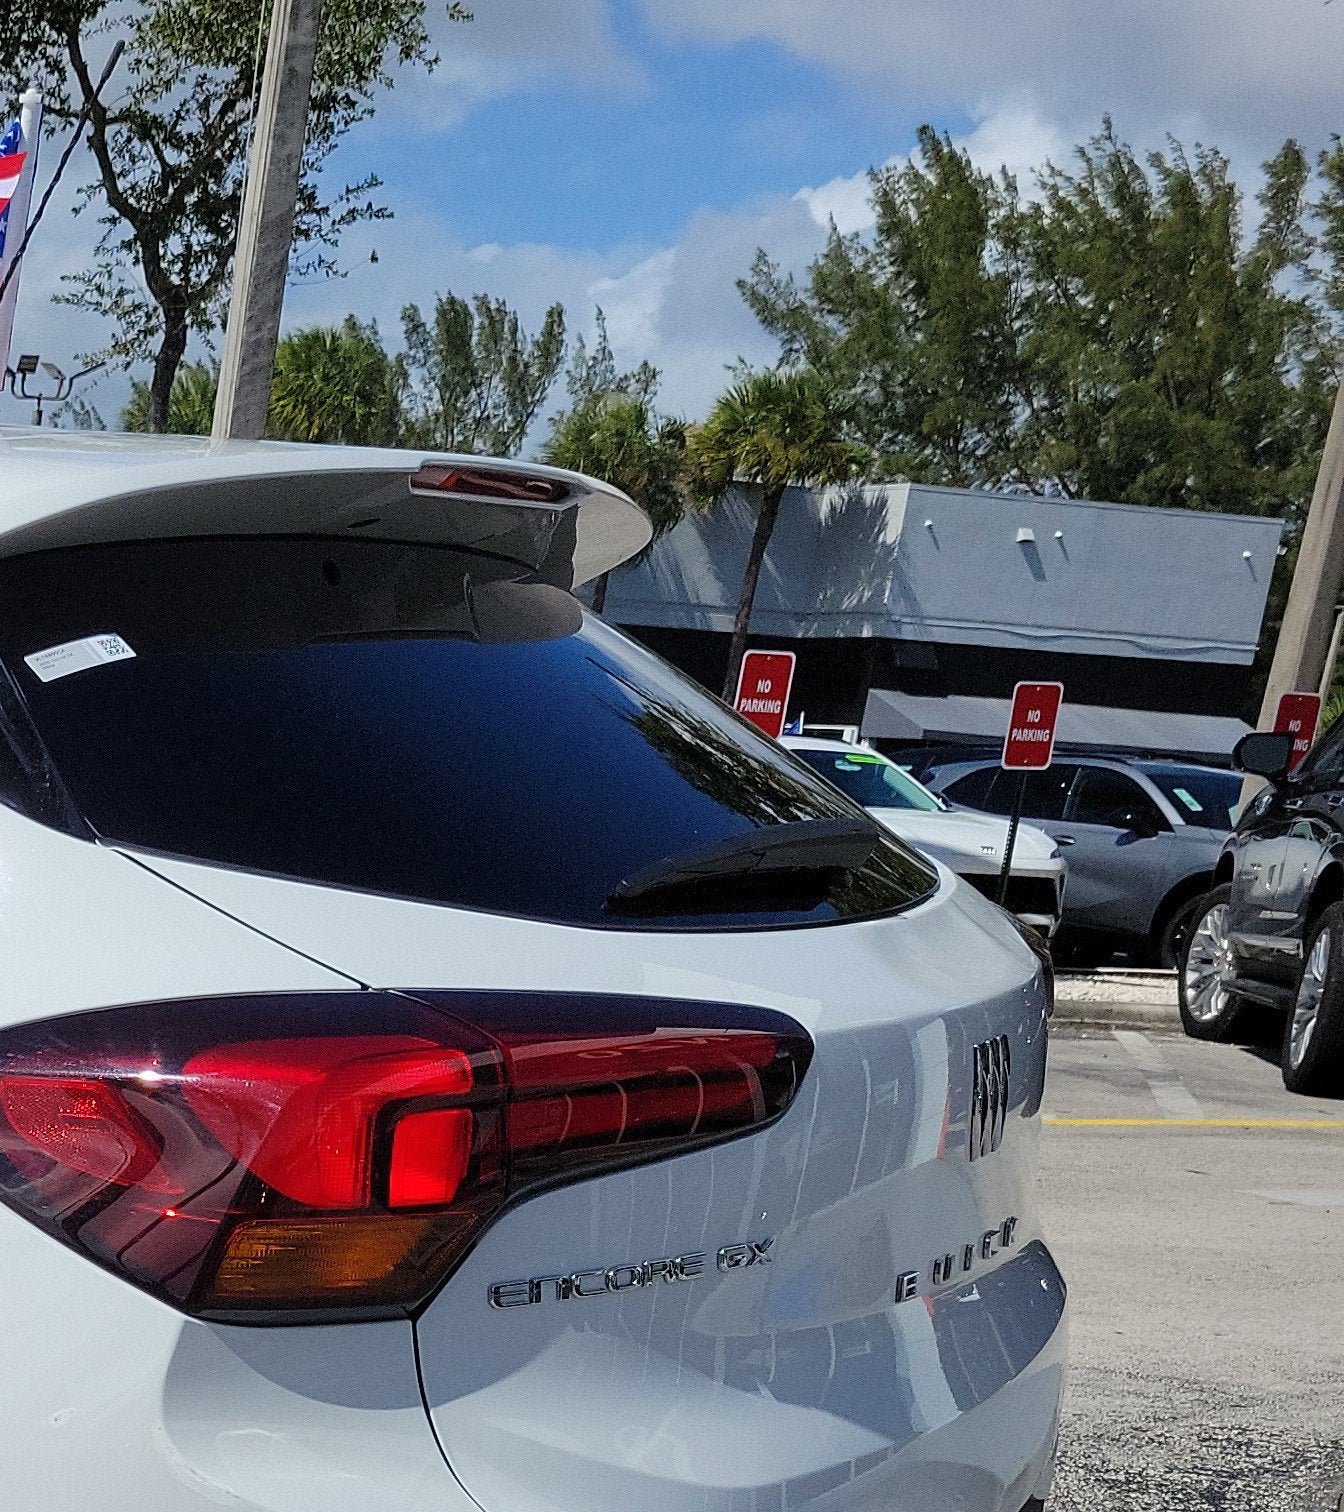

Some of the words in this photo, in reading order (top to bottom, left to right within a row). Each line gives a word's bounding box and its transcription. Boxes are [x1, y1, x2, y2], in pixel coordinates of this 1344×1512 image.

[756, 679, 772, 694] NO
[739, 697, 782, 714] PARKING
[1026, 709, 1041, 723] NO
[1288, 719, 1303, 733] NO
[1011, 728, 1050, 743] PARKING
[487, 1251, 708, 1309] ENCORE
[716, 1235, 777, 1273] GX
